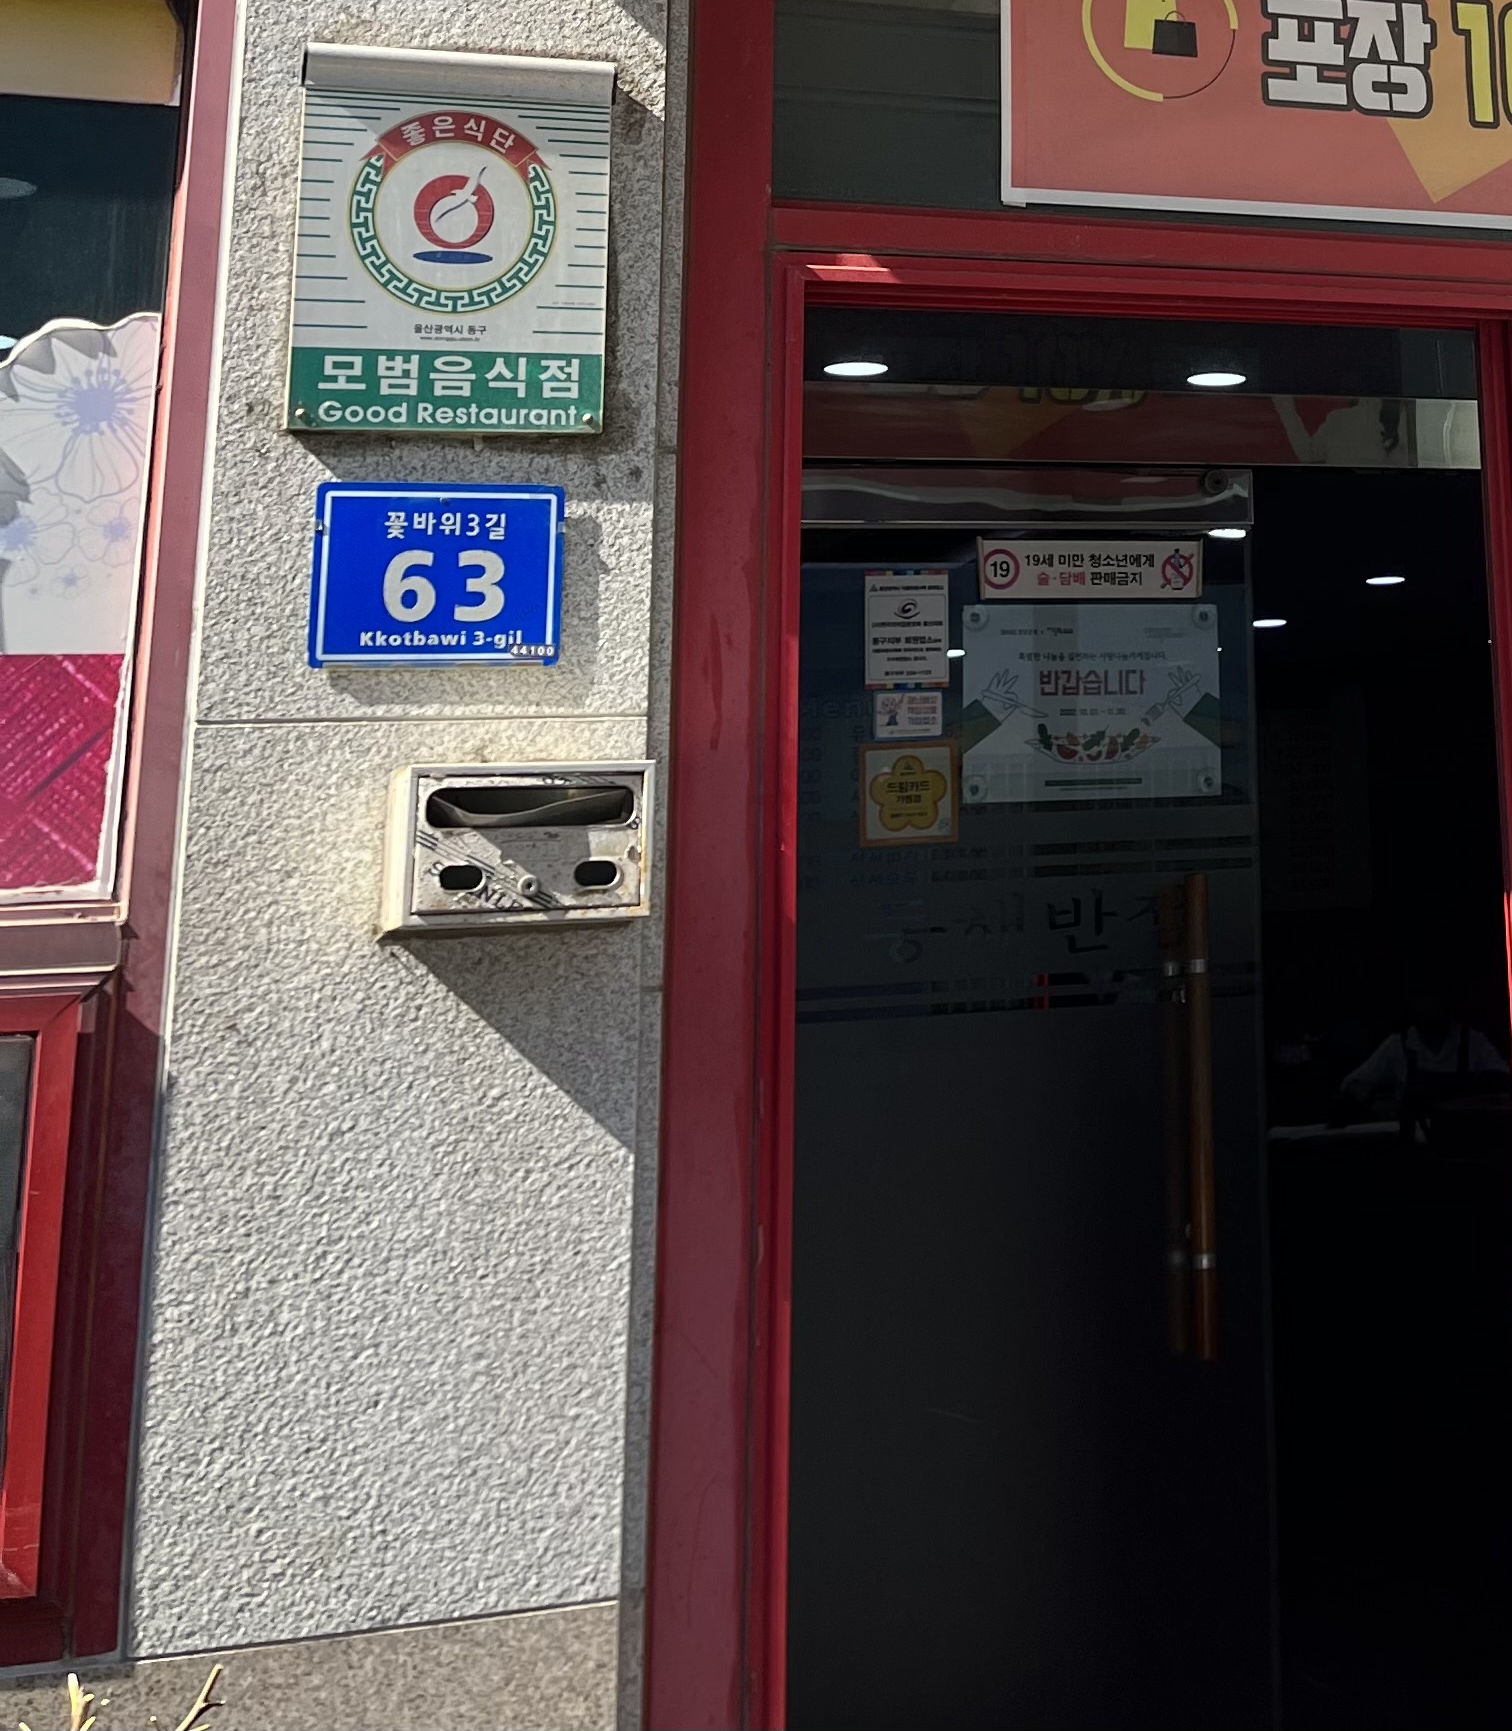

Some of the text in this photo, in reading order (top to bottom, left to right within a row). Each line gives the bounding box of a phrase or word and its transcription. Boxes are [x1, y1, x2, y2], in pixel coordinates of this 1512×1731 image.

[402, 114, 516, 154] 좋은식단
[413, 324, 487, 336] 울산광역시 동구
[317, 353, 581, 399] 모범음식점
[317, 400, 577, 427] Good Restaurant
[384, 511, 507, 541] 꽃바위3길
[989, 560, 1010, 578] 19
[1024, 552, 1155, 568] 19세 미만 청소년에게
[382, 549, 506, 623] 63
[1089, 571, 1143, 587] 판매금지
[359, 630, 523, 649] Kkotbawi 3-gil
[510, 644, 555, 657] 44100
[1039, 668, 1147, 697] 반갑습니다
